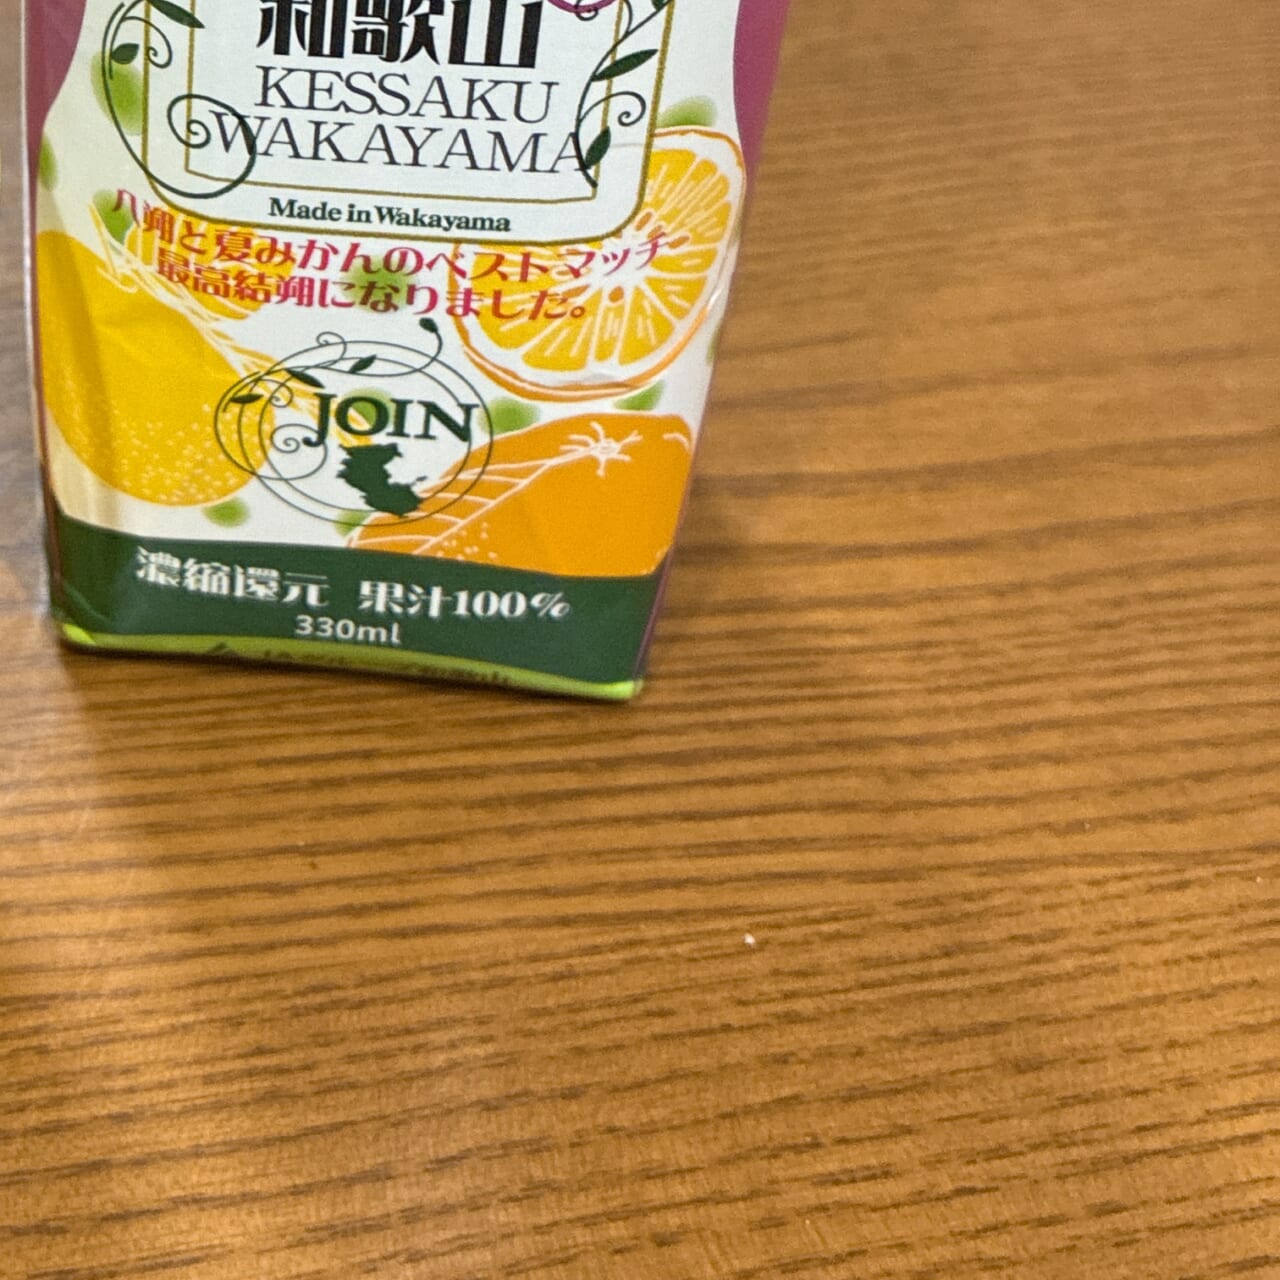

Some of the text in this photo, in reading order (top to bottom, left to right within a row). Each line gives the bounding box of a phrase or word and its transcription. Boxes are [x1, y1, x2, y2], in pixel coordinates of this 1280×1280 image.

[254, 65, 560, 125] KESSAKU
[208, 110, 592, 174] WAKAYAMA
[112, 188, 671, 284] 八朔と夏みかんのベストマッチ
[268, 197, 513, 233] Made in Wakayama
[157, 246, 586, 321] 最高結朔になりました。
[302, 391, 481, 447] JOIN
[135, 545, 572, 619] 濃縮還元 果汁100%
[294, 614, 402, 646] 330ml
